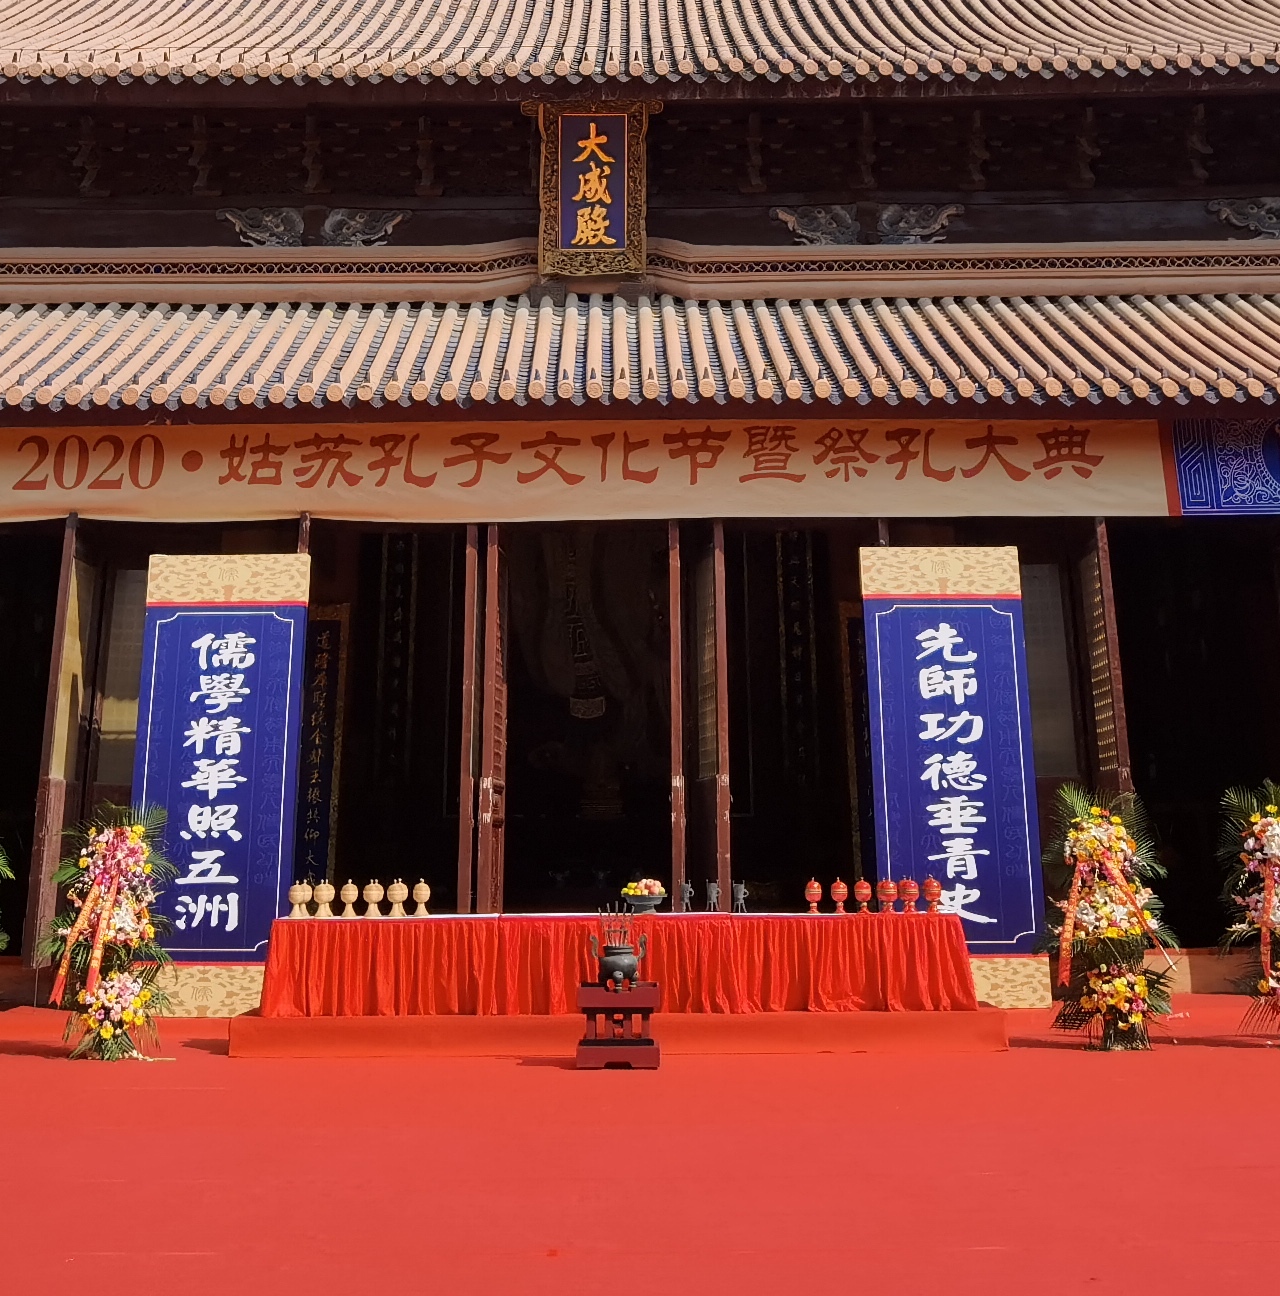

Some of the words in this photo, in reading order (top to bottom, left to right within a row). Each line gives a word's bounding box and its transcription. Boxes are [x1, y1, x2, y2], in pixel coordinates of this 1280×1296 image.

[571, 122, 617, 245] 大成殿
[174, 631, 256, 932] 儒學精華照五洲
[915, 622, 998, 923] 先師功德垂青史
